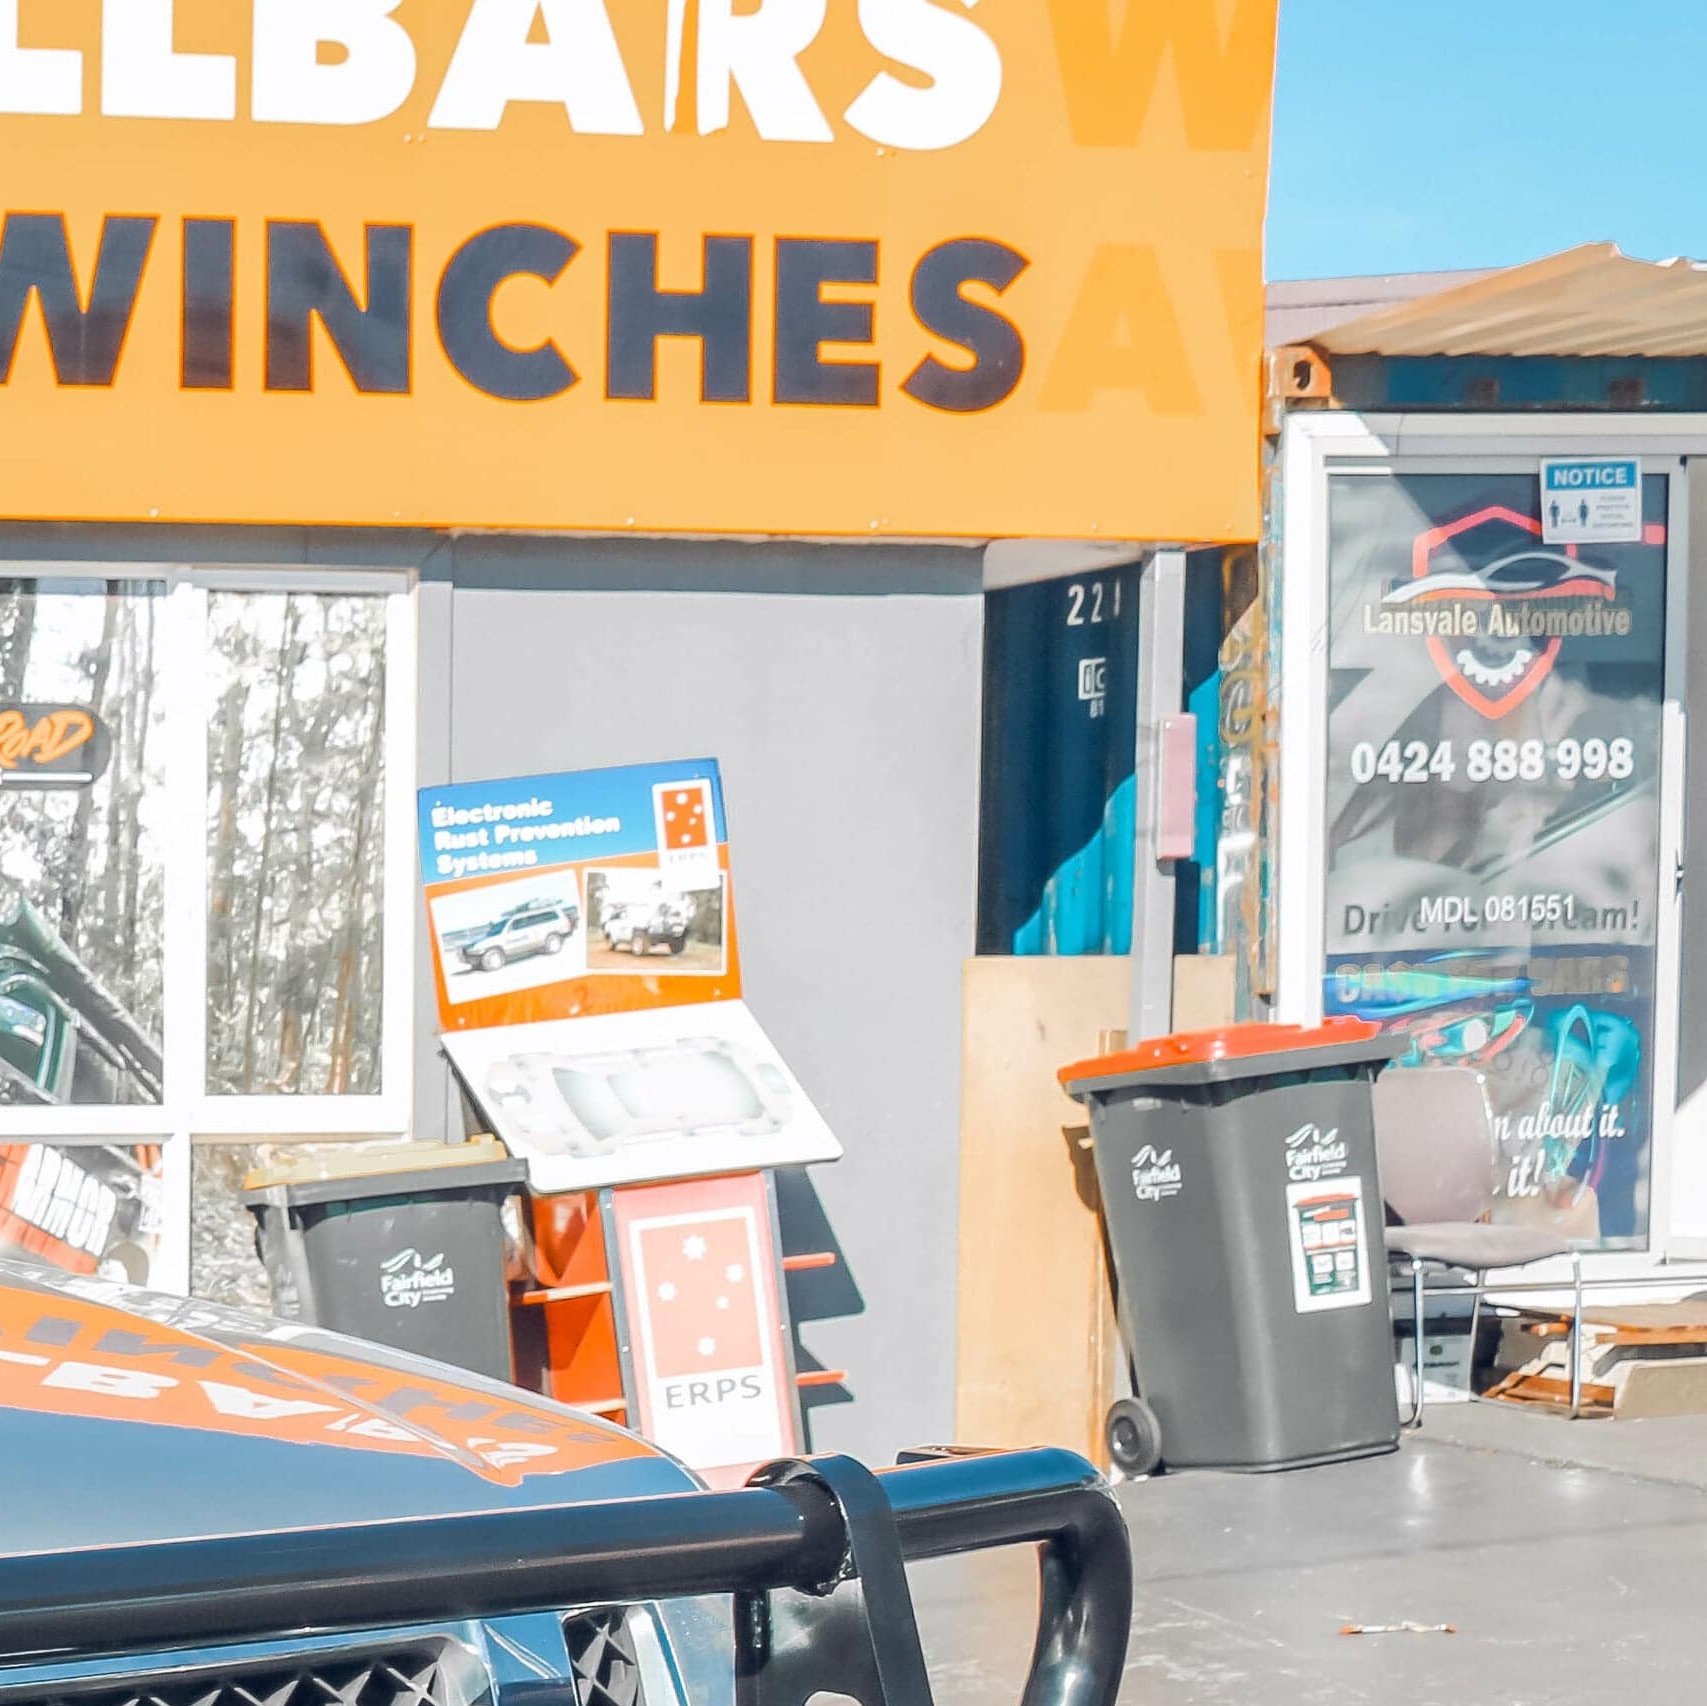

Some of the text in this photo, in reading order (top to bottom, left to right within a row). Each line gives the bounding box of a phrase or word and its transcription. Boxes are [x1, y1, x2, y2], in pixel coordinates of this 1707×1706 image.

[1553, 466, 1628, 486] NOTICE
[1363, 601, 1631, 636] Lansvale Automotive
[1350, 737, 1635, 784] 0424 888 998
[431, 798, 554, 828] Electronic
[434, 816, 621, 851] Rust Prevention
[437, 849, 538, 878] Systems
[1420, 897, 1479, 924] MDL
[1485, 894, 1575, 922] 081551
[1518, 1102, 1593, 1140] about
[1507, 1148, 1545, 1198] it!
[381, 1267, 454, 1294] Fairfield
[384, 1290, 422, 1308] City
[665, 1374, 763, 1410] ERPS
